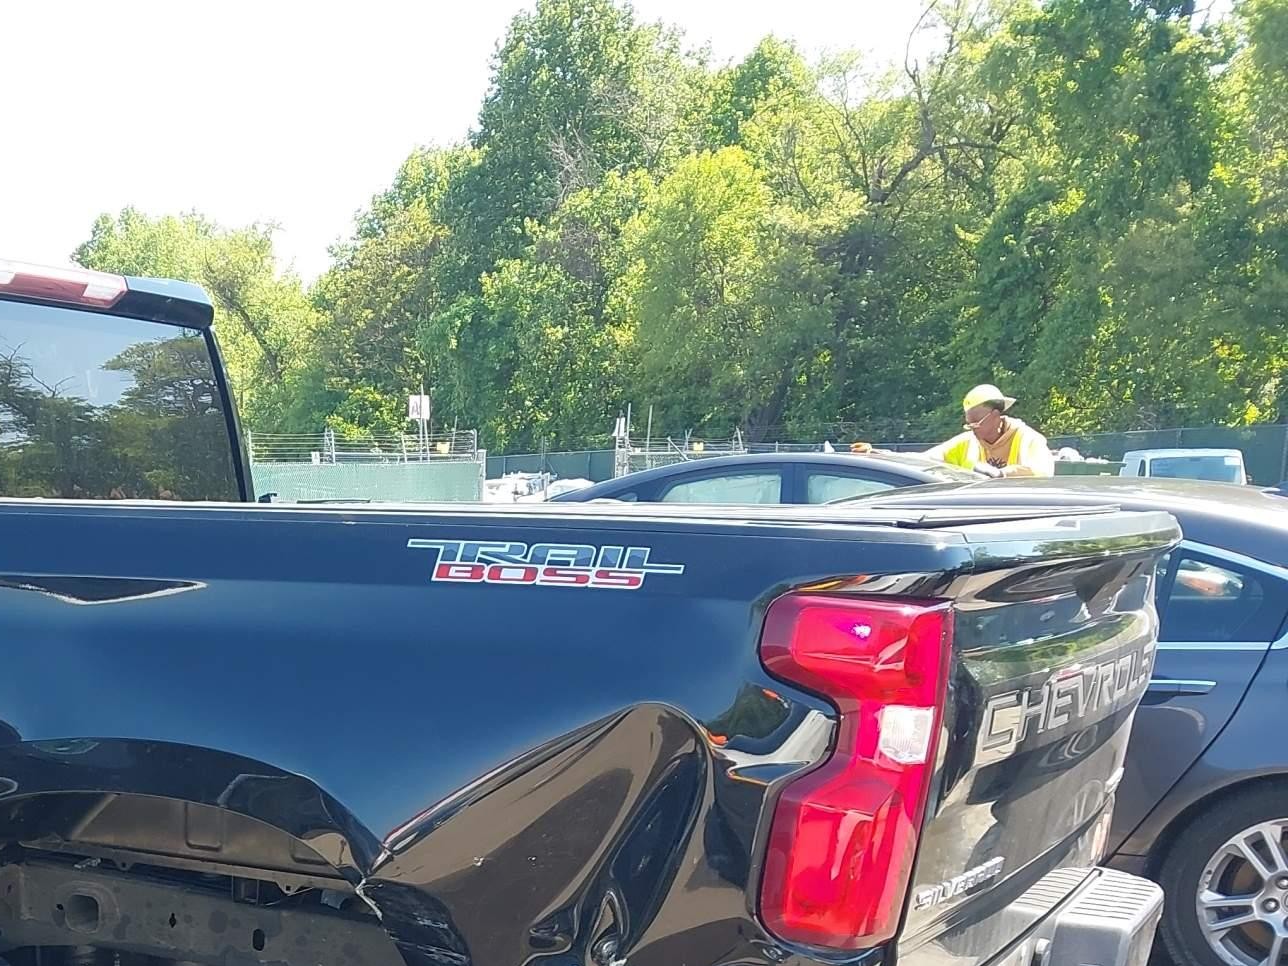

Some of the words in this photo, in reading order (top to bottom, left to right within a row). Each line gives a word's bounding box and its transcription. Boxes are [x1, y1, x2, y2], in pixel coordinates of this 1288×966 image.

[407, 538, 685, 575] TRAIL
[431, 562, 646, 590] BOSS
[981, 641, 1155, 752] CHEVROLE
